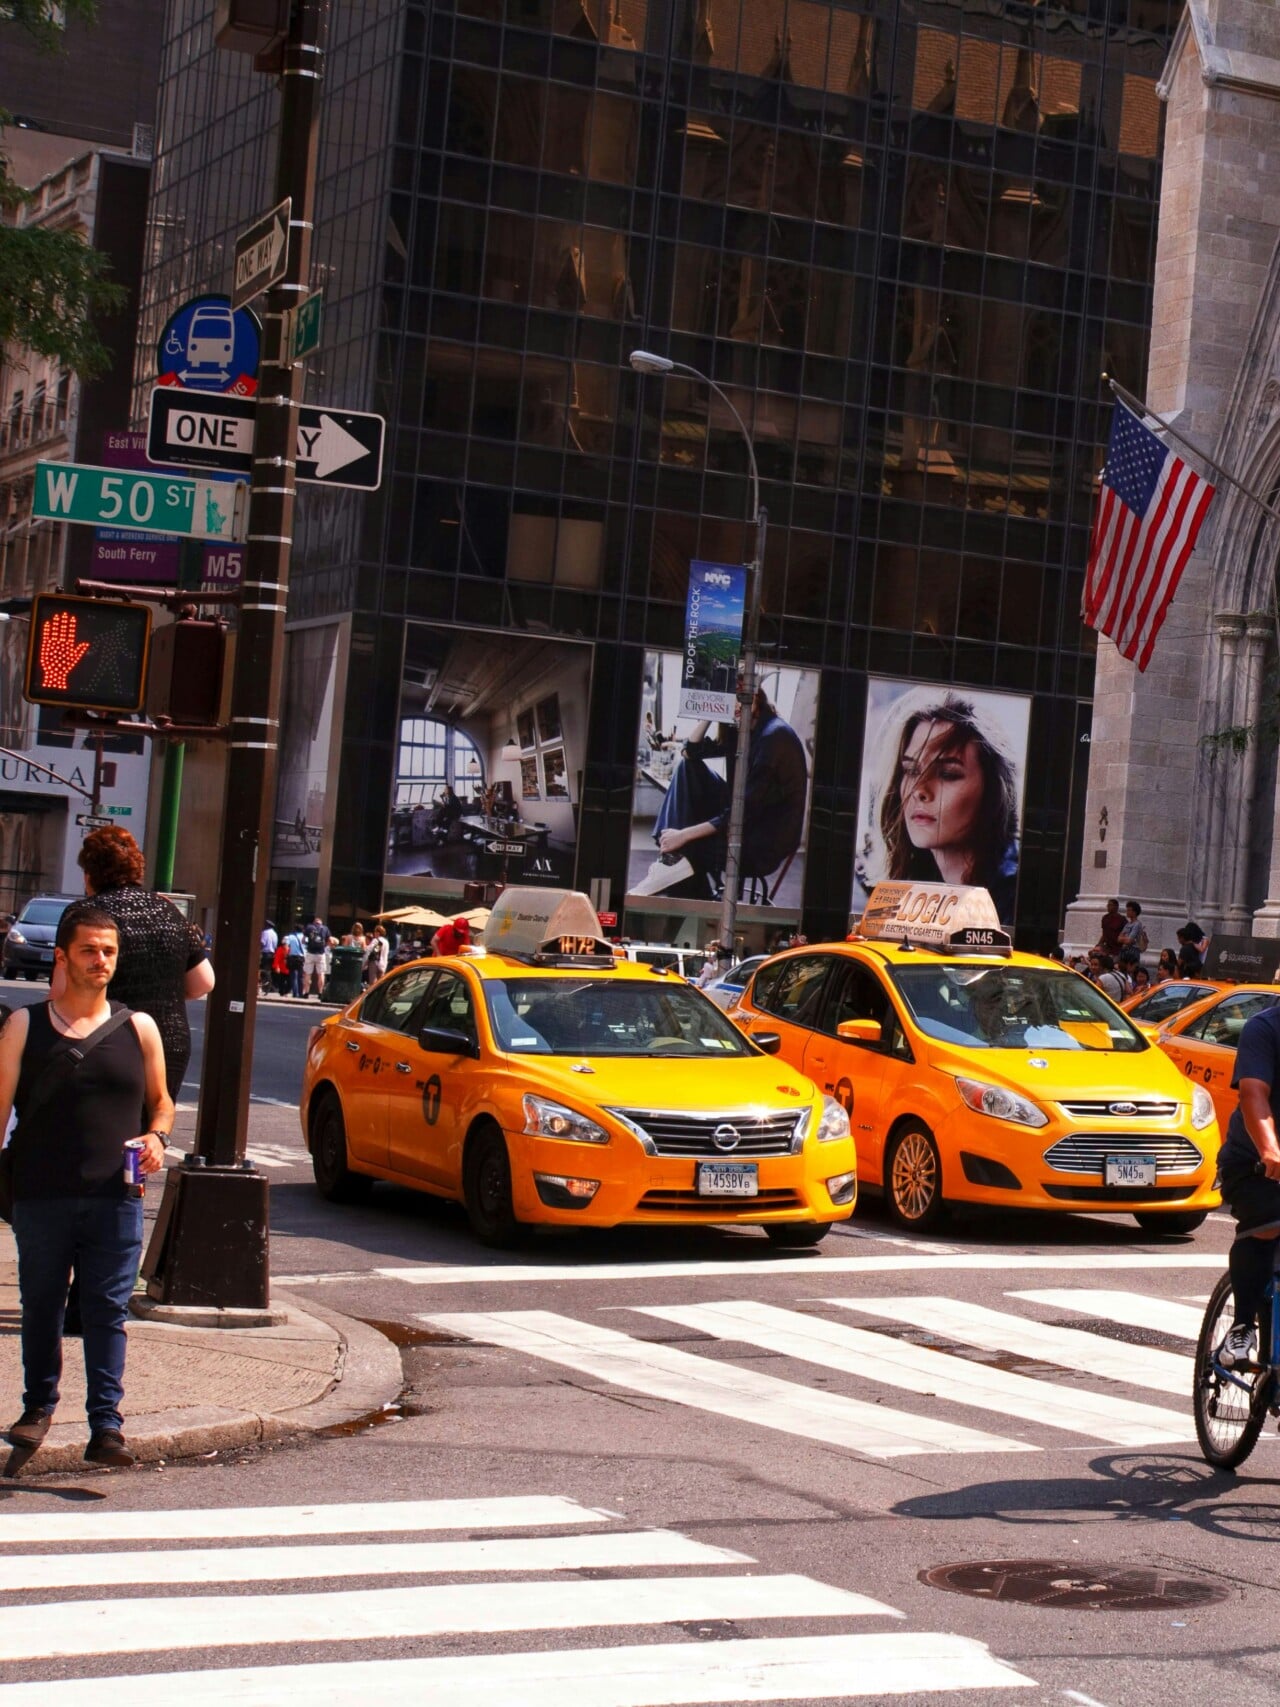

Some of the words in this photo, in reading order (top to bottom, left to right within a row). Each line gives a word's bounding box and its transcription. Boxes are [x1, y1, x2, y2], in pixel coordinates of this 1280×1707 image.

[238, 253, 253, 284] ONE
[257, 235, 274, 268] WAY
[176, 415, 238, 448] ONE
[109, 436, 129, 449] East
[47, 470, 79, 513] W
[98, 477, 155, 523] 50
[166, 484, 195, 508] ST
[98, 546, 126, 560] South
[130, 548, 156, 564] Ferry
[207, 553, 241, 579] M5
[704, 571, 731, 586] NYC
[690, 588, 701, 618] ROCK
[688, 618, 699, 642] THE
[688, 641, 697, 659] OF
[685, 659, 697, 681] TOP
[703, 692, 725, 702] YORK
[685, 699, 725, 715] CityPASS
[1, 758, 87, 787] URLA
[896, 891, 958, 926] LOGIC
[885, 924, 913, 935] ELECTRONIC
[913, 926, 944, 938] CIGARETTES
[965, 930, 993, 945] 5N45
[558, 936, 596, 954] 1H72
[1228, 953, 1264, 965] SQUARESPACE
